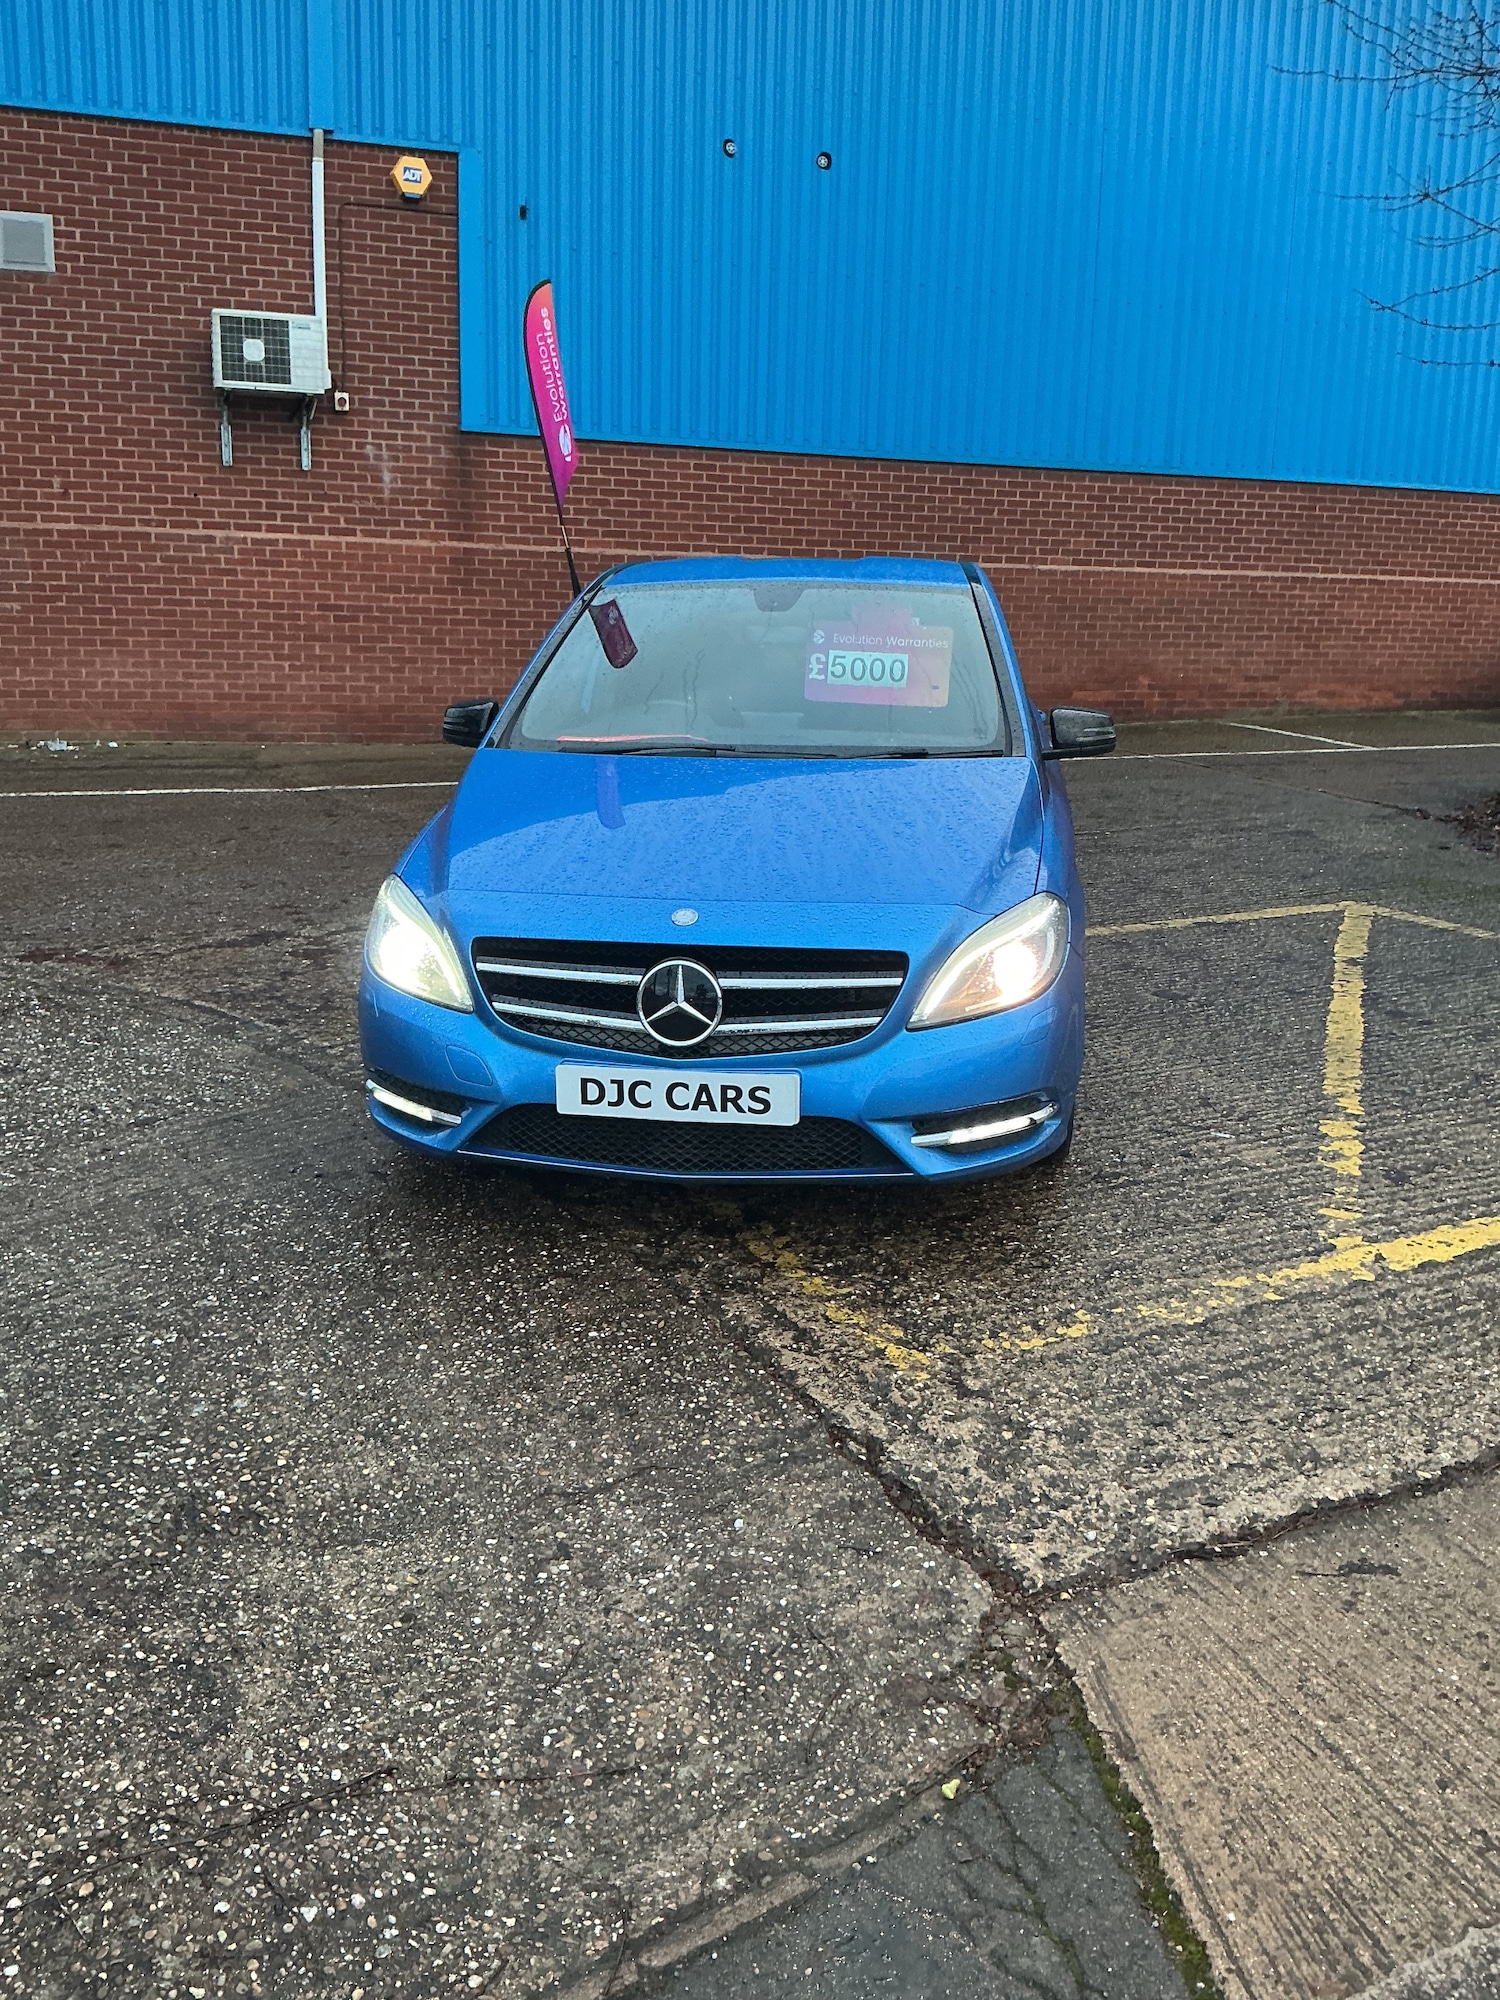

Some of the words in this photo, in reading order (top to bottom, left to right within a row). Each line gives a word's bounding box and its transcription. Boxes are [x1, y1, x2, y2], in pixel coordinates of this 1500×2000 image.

[403, 169, 422, 181] ADT
[536, 333, 563, 423] Evolution
[833, 633, 883, 645] Evolution
[886, 636, 949, 648] Warranties
[580, 1077, 652, 1109] DJC
[665, 1081, 772, 1115] CARS
